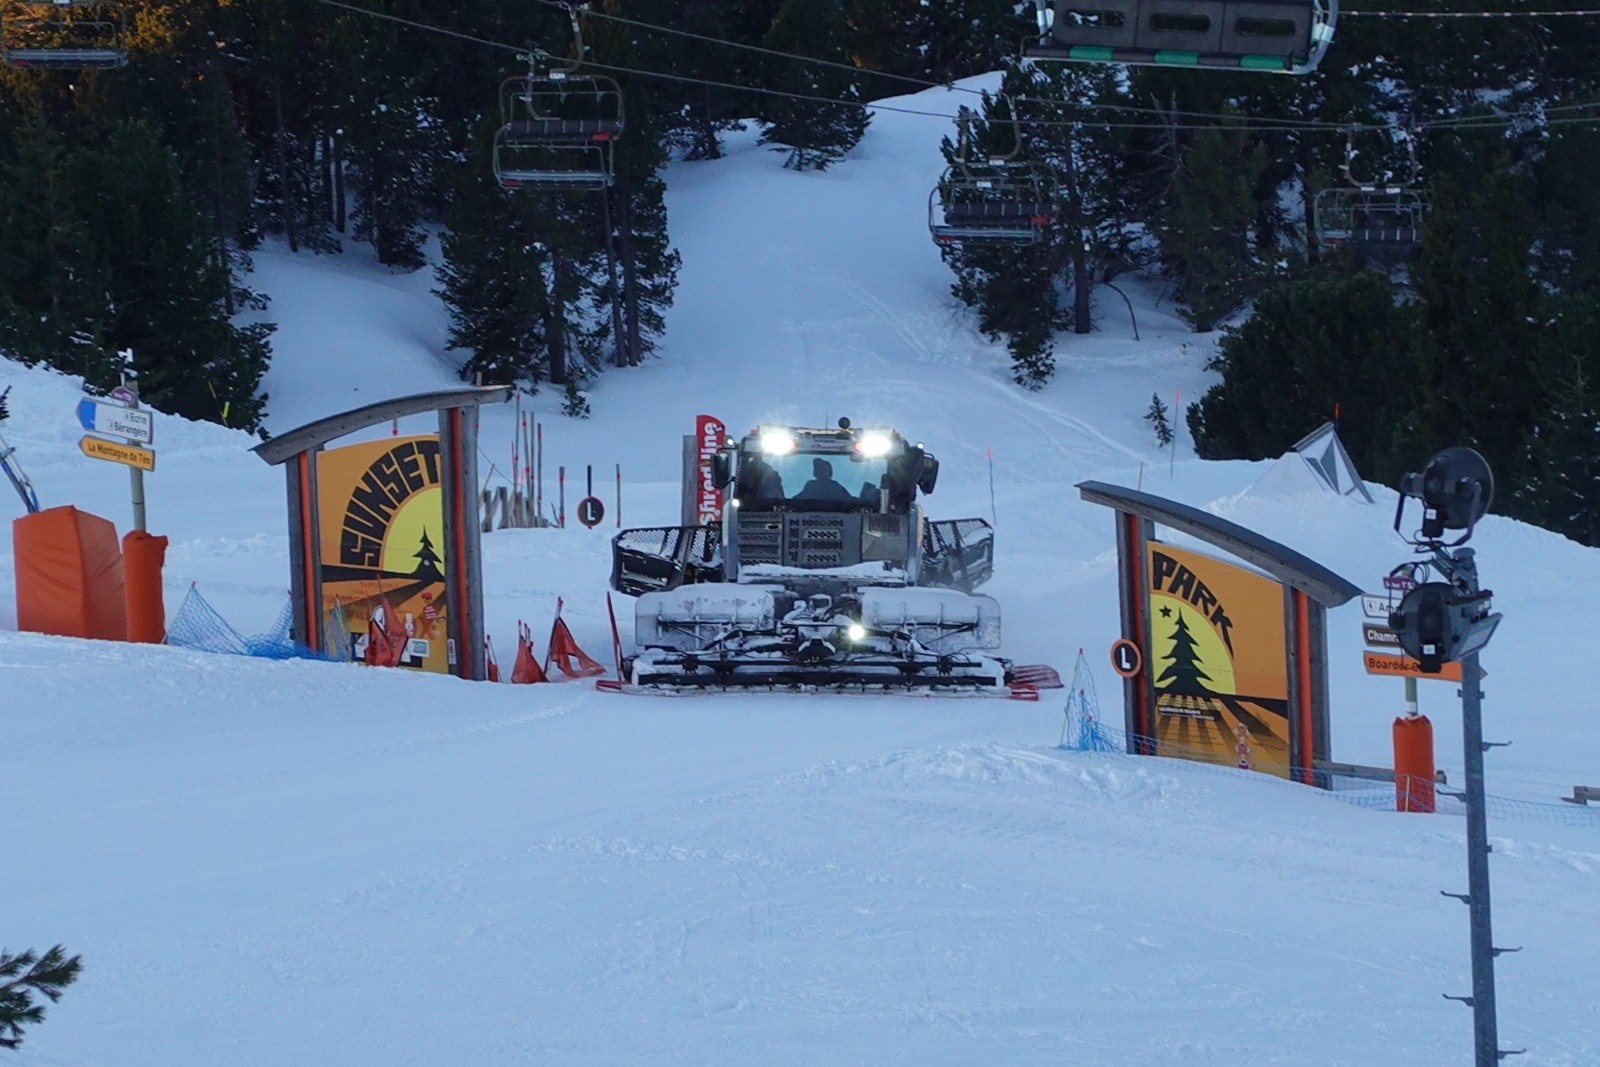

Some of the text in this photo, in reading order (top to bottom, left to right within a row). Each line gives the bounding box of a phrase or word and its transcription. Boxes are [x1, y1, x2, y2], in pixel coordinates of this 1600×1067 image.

[97, 444, 128, 459] Montagne
[130, 452, 138, 461] de
[340, 440, 441, 568] SUNSET
[586, 502, 596, 521] L
[1152, 550, 1234, 659] PARK
[1121, 647, 1131, 669] L
[1368, 657, 1409, 671] Boarder
